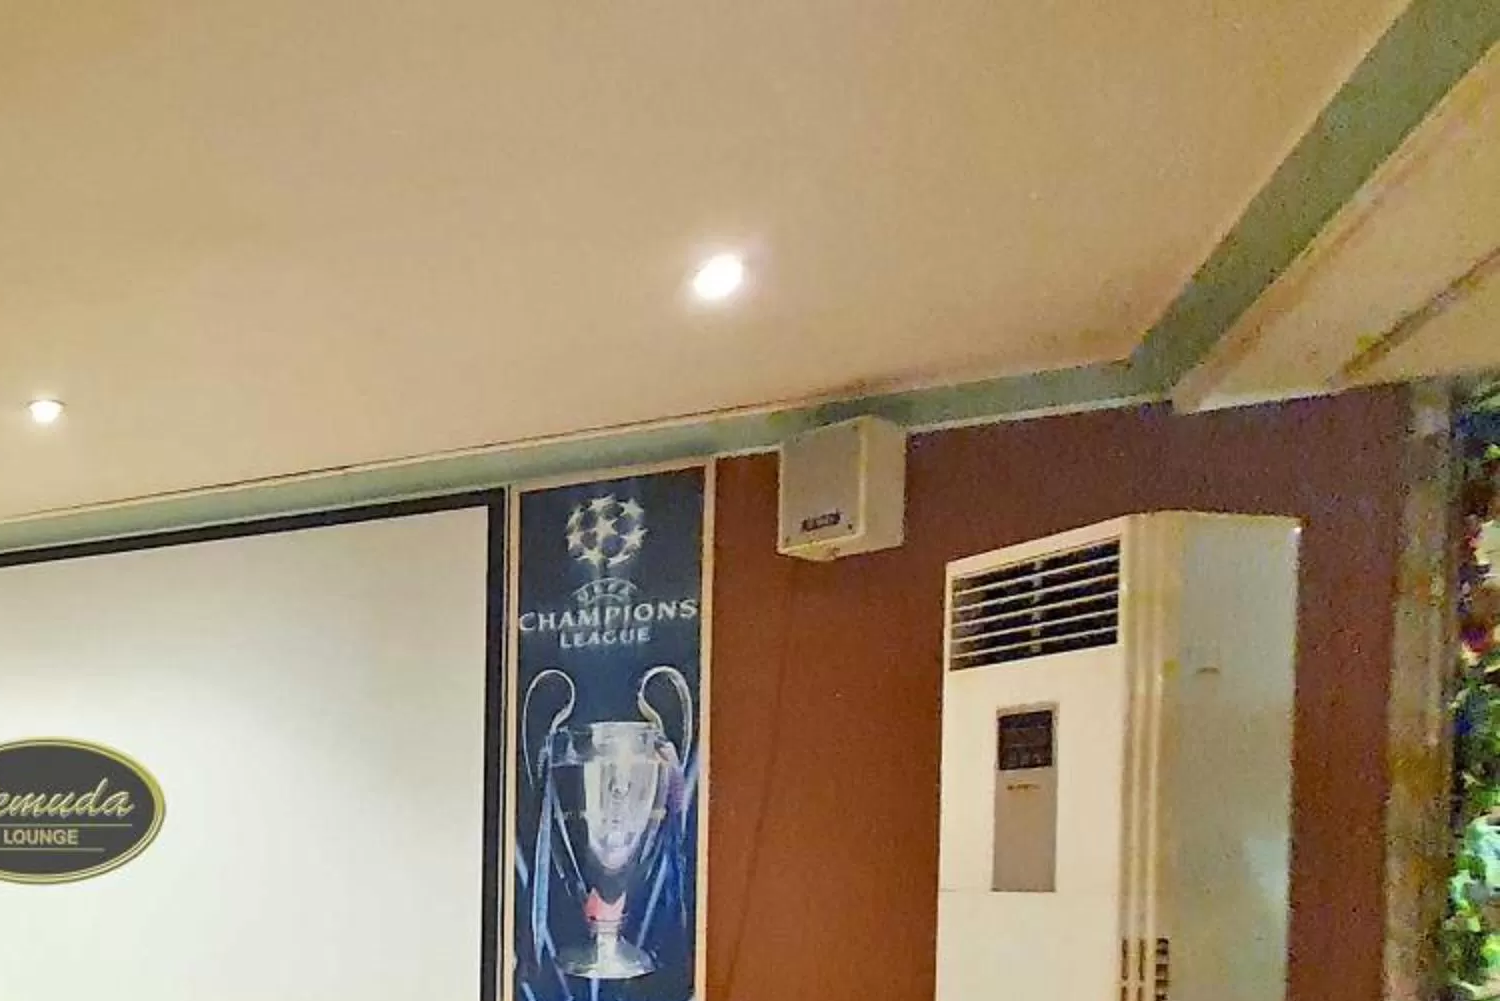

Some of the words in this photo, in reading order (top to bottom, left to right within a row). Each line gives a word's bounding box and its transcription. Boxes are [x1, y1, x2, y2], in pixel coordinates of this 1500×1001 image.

[519, 599, 698, 631] CHAMPIONS
[560, 627, 650, 648] LEAGUE
[3, 828, 79, 845] LOUNGE
